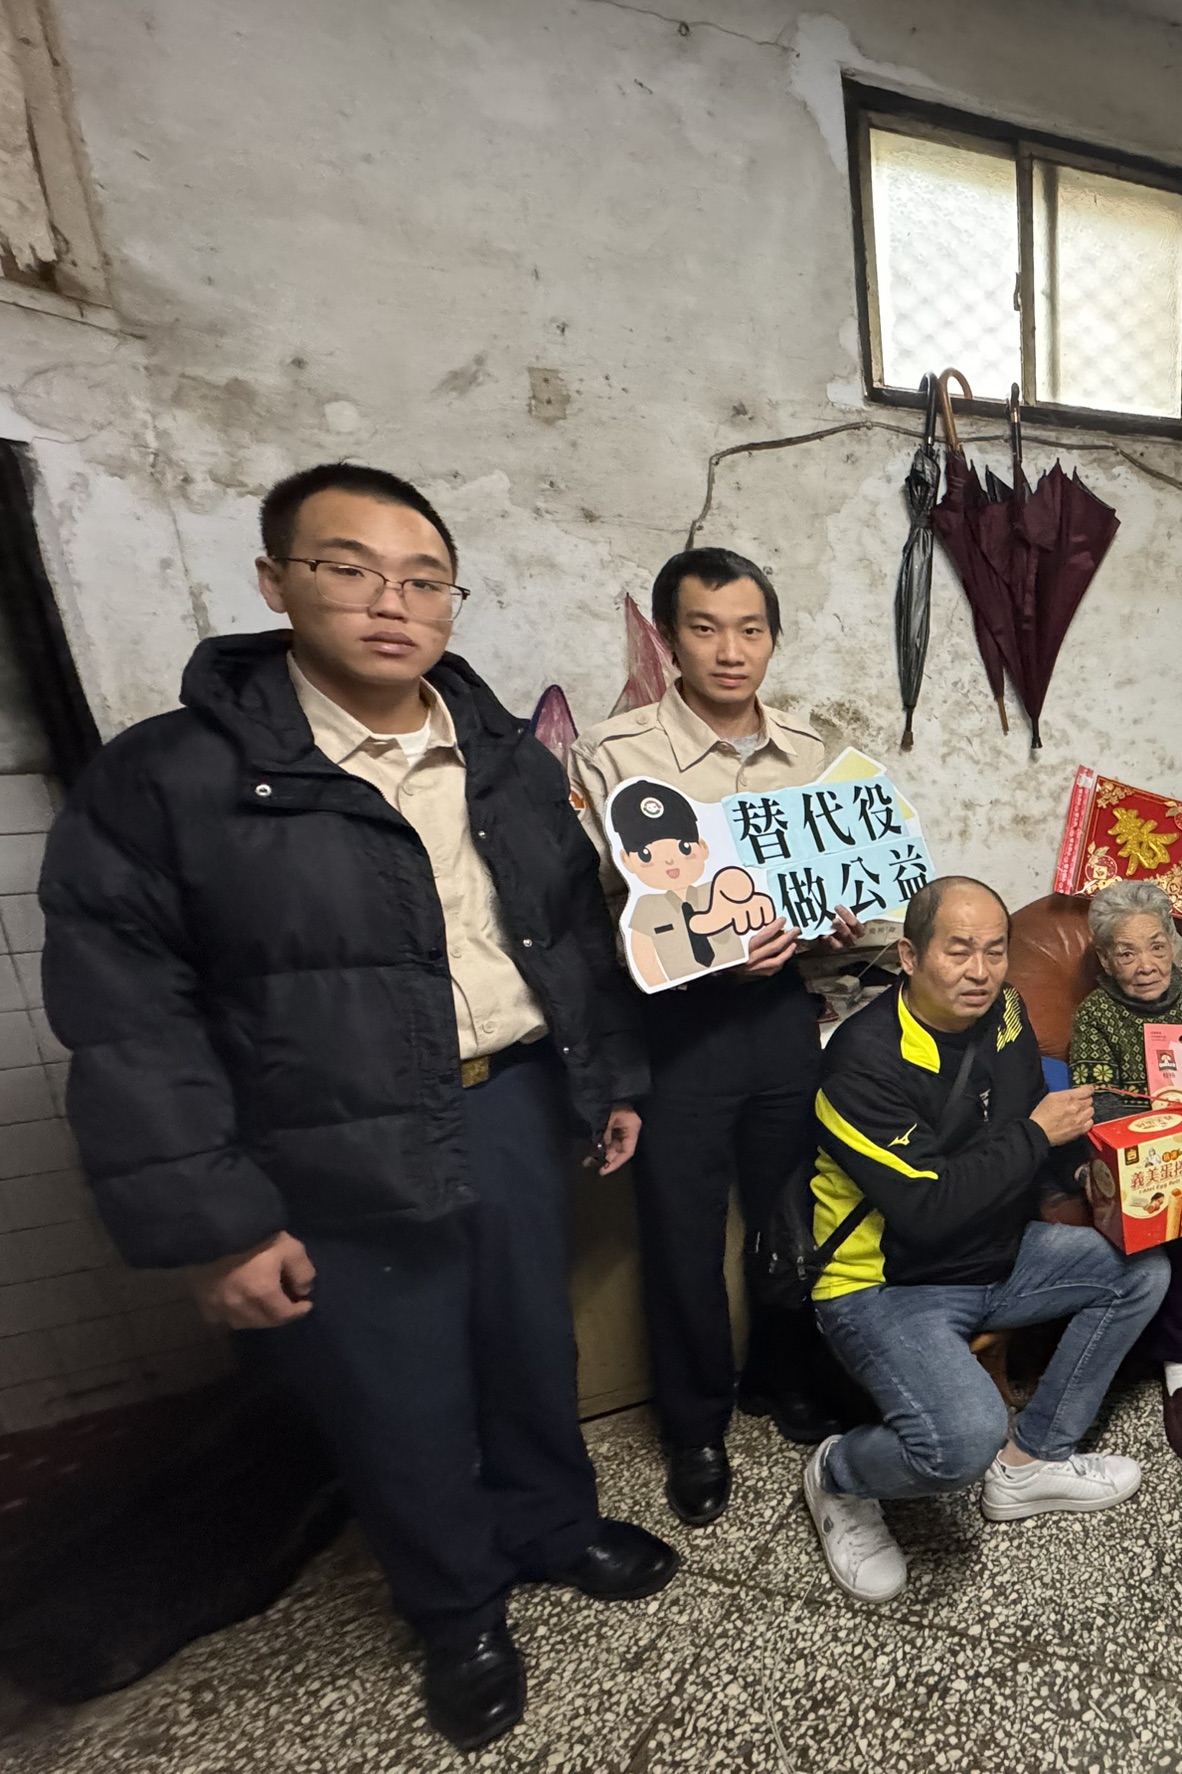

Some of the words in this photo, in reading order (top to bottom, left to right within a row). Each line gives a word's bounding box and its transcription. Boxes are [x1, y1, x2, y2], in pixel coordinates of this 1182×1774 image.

[733, 783, 902, 865] 替代役
[777, 844, 929, 931] 做公益
